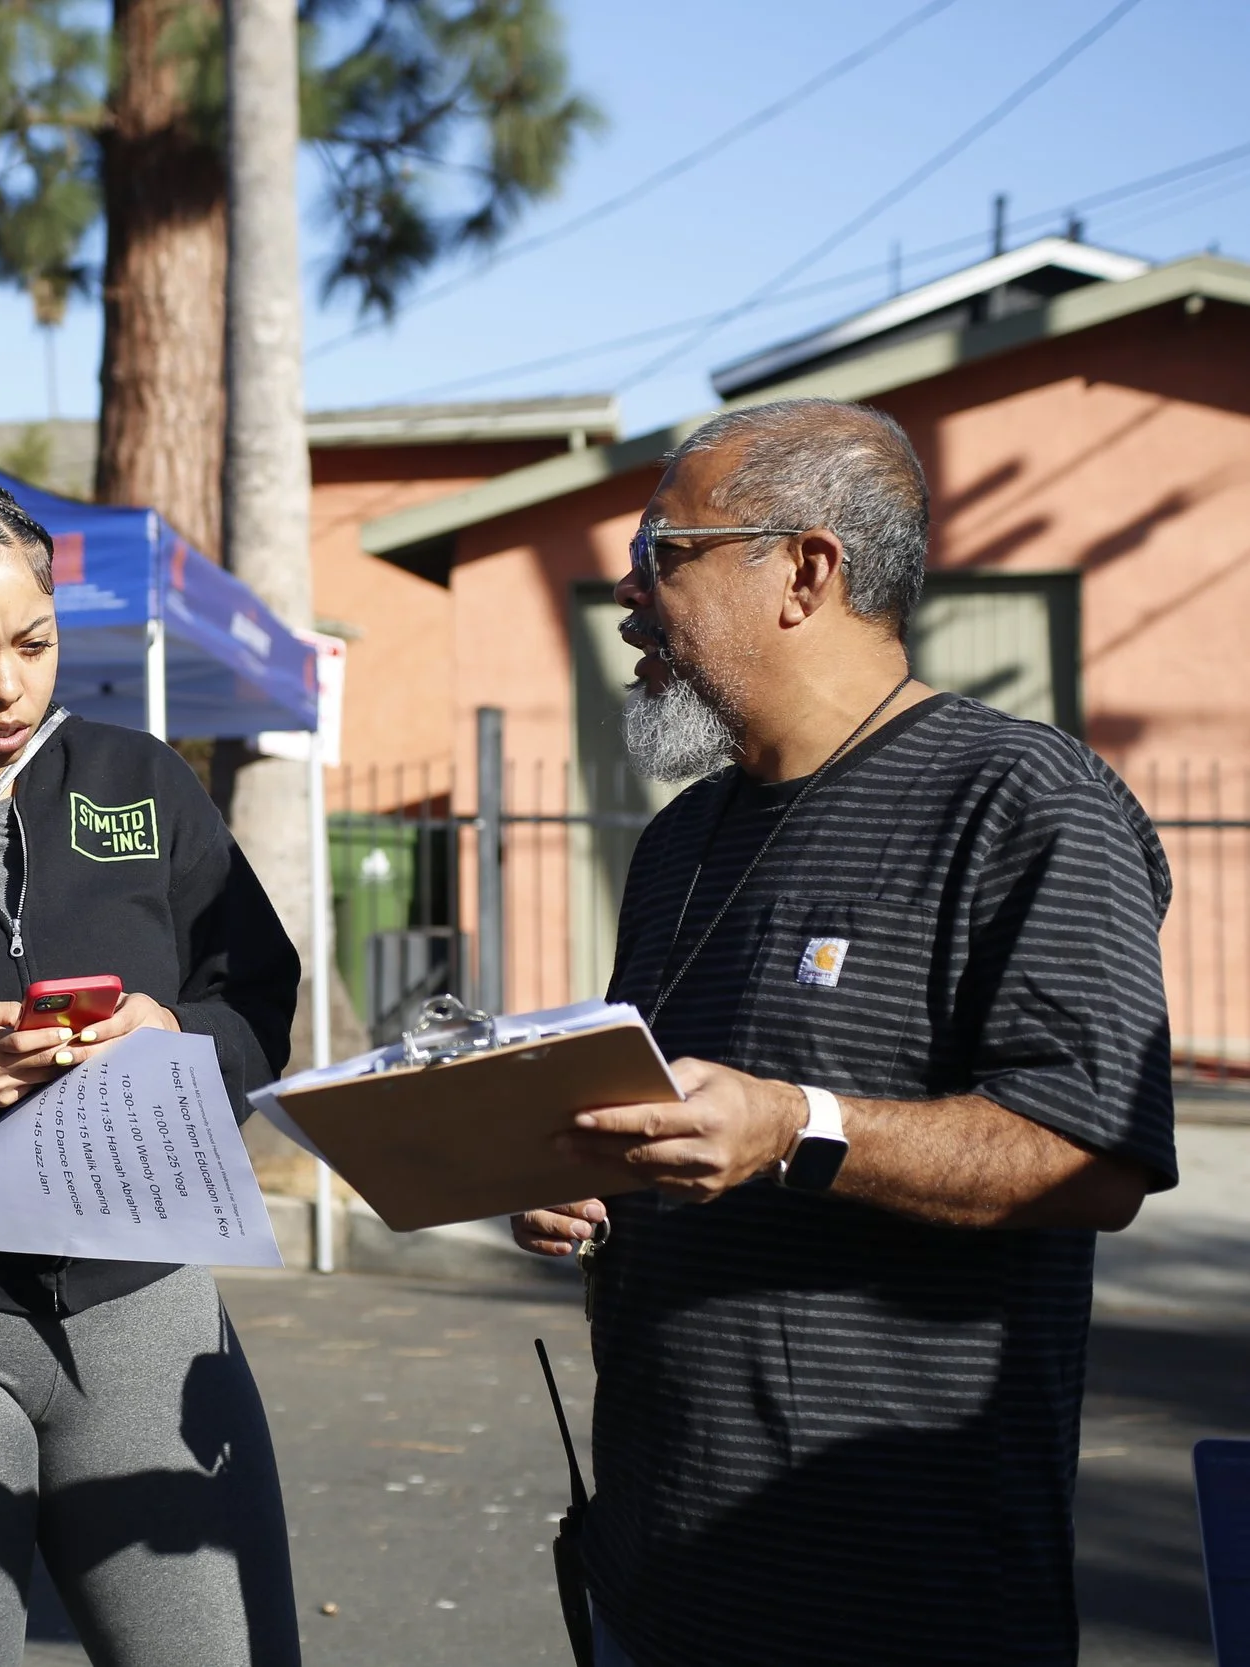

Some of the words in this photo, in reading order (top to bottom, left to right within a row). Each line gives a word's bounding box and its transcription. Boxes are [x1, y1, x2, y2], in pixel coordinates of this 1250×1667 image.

[79, 804, 145, 834] STMLTD
[169, 1061, 184, 1092] Host:
[76, 1069, 90, 1139] 11:50-12:15
[177, 1095, 191, 1121] Nico
[98, 1062, 114, 1133] 11:10-11:35
[106, 1135, 127, 1178] Hannah
[119, 1180, 142, 1224] Abrahim
[121, 1073, 144, 1142] 10:30-11:00
[136, 1144, 155, 1182] Wendy
[149, 1184, 168, 1220] Ortega
[152, 1104, 181, 1169] 10:00-10:25
[173, 1170, 189, 1197] Yoga
[185, 1123, 200, 1148] from
[34, 1139, 44, 1168] Jazz
[81, 1142, 98, 1171] Malik
[38, 1170, 51, 1195] Jam
[55, 1129, 69, 1168] Dance
[63, 1170, 84, 1216] Exercise
[194, 1151, 219, 1203] Education
[90, 1174, 111, 1215] Deering
[213, 1205, 223, 1215] is
[216, 1217, 231, 1239] Key
